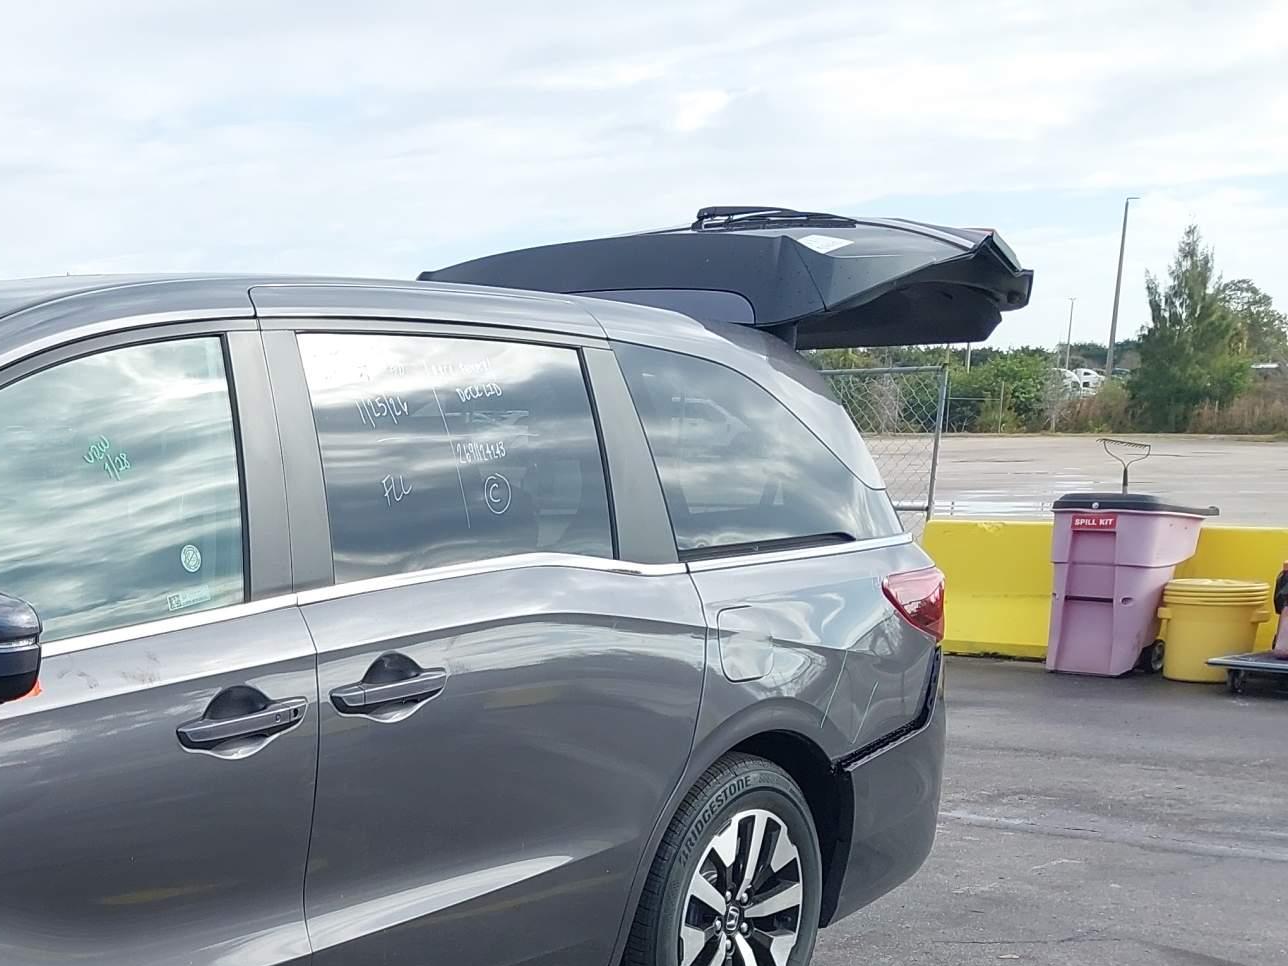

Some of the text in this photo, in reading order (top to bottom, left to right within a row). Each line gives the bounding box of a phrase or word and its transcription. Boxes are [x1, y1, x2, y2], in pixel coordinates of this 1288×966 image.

[1074, 518, 1115, 526] SPILL KIT
[679, 774, 752, 868] BRIDGESTONE
